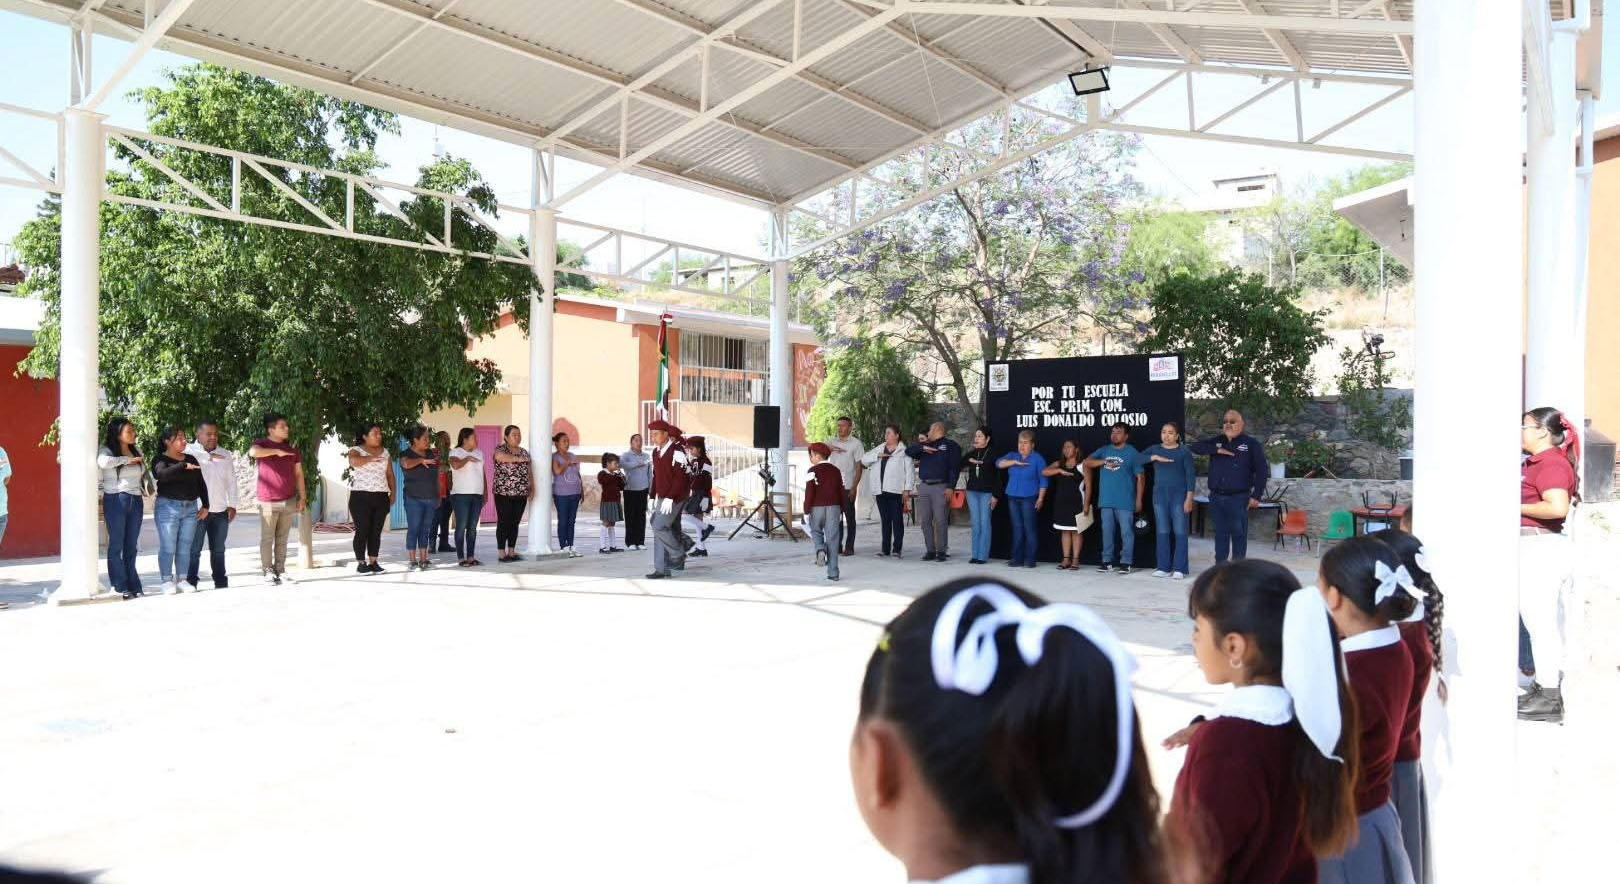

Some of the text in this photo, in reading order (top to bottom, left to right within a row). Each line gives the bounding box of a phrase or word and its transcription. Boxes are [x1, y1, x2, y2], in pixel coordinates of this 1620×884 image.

[1031, 383, 1129, 400] POR TU ESCUELA
[1033, 398, 1127, 413] ESC. PRIM. COM.
[1016, 414, 1039, 428] LUIS
[1043, 413, 1096, 427] DONALDO
